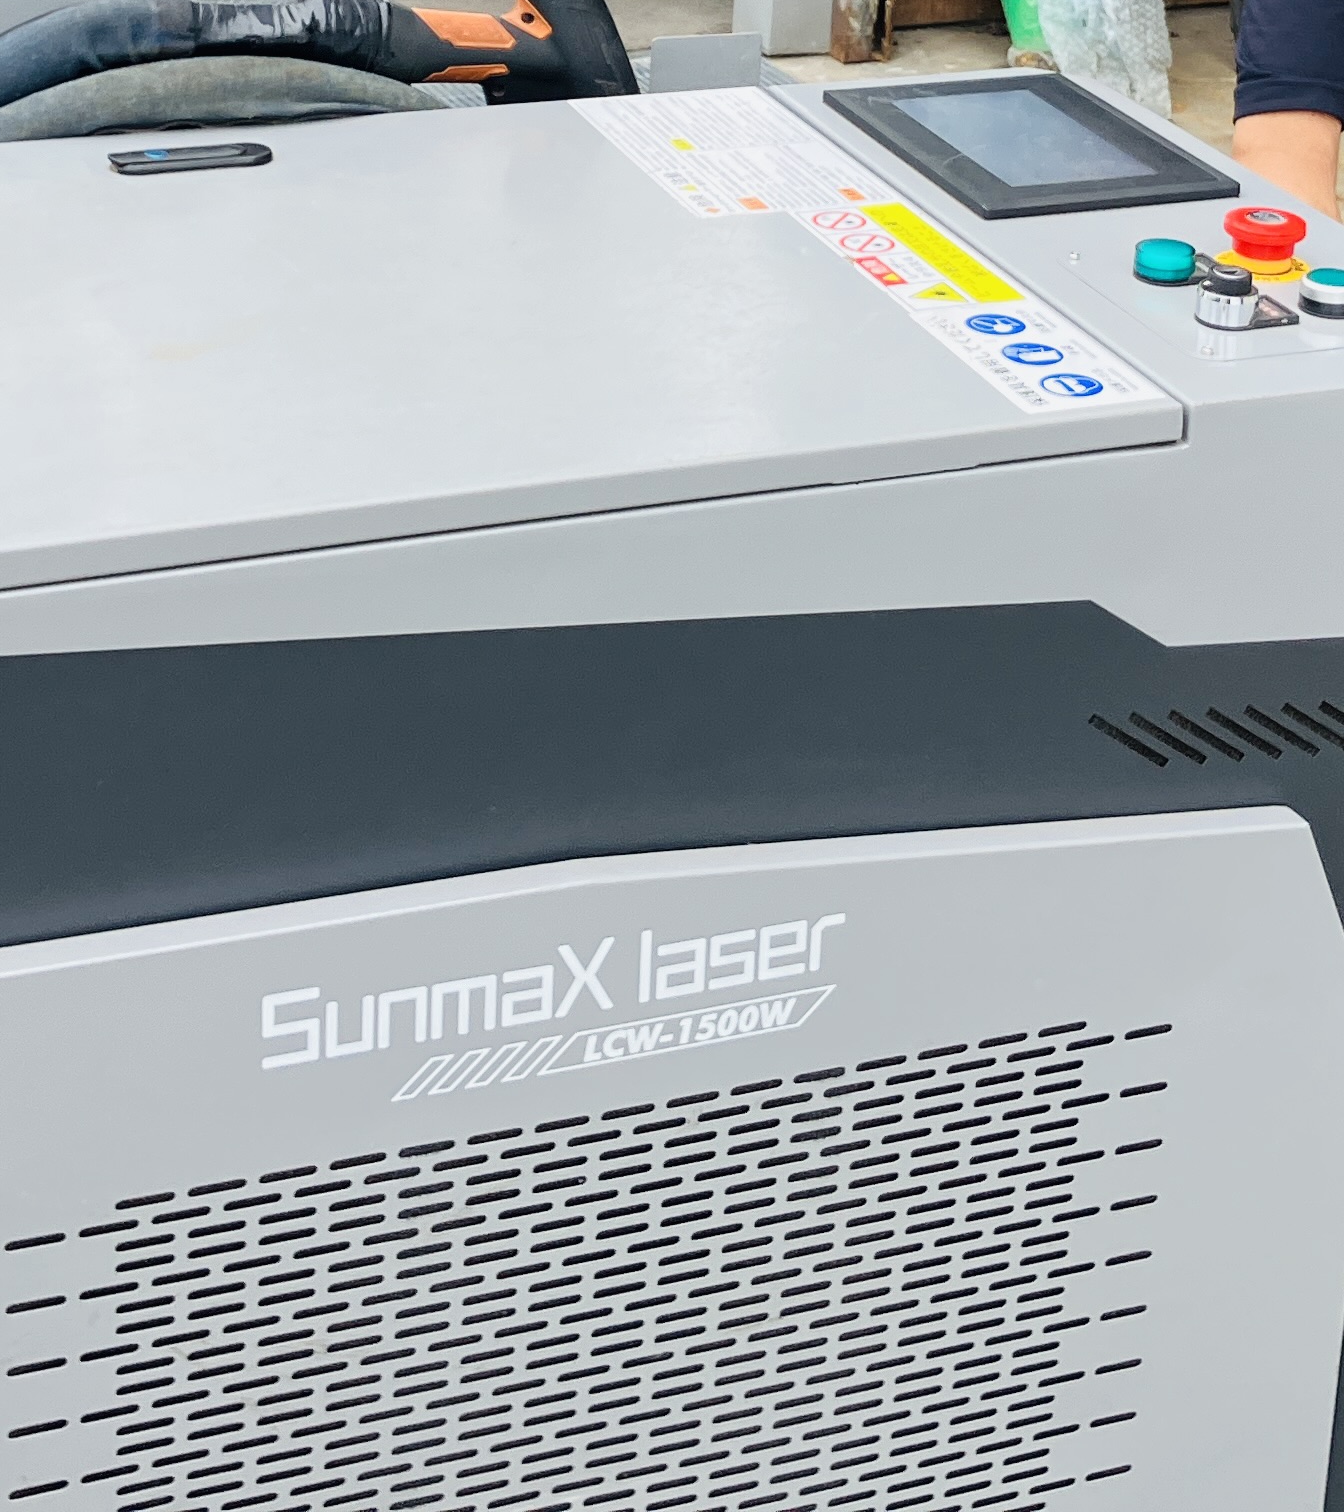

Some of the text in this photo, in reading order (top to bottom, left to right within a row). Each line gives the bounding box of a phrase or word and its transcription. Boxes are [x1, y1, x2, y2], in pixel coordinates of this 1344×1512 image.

[259, 912, 847, 1070] SunmaX laser
[583, 997, 797, 1064] LCW-1500W
